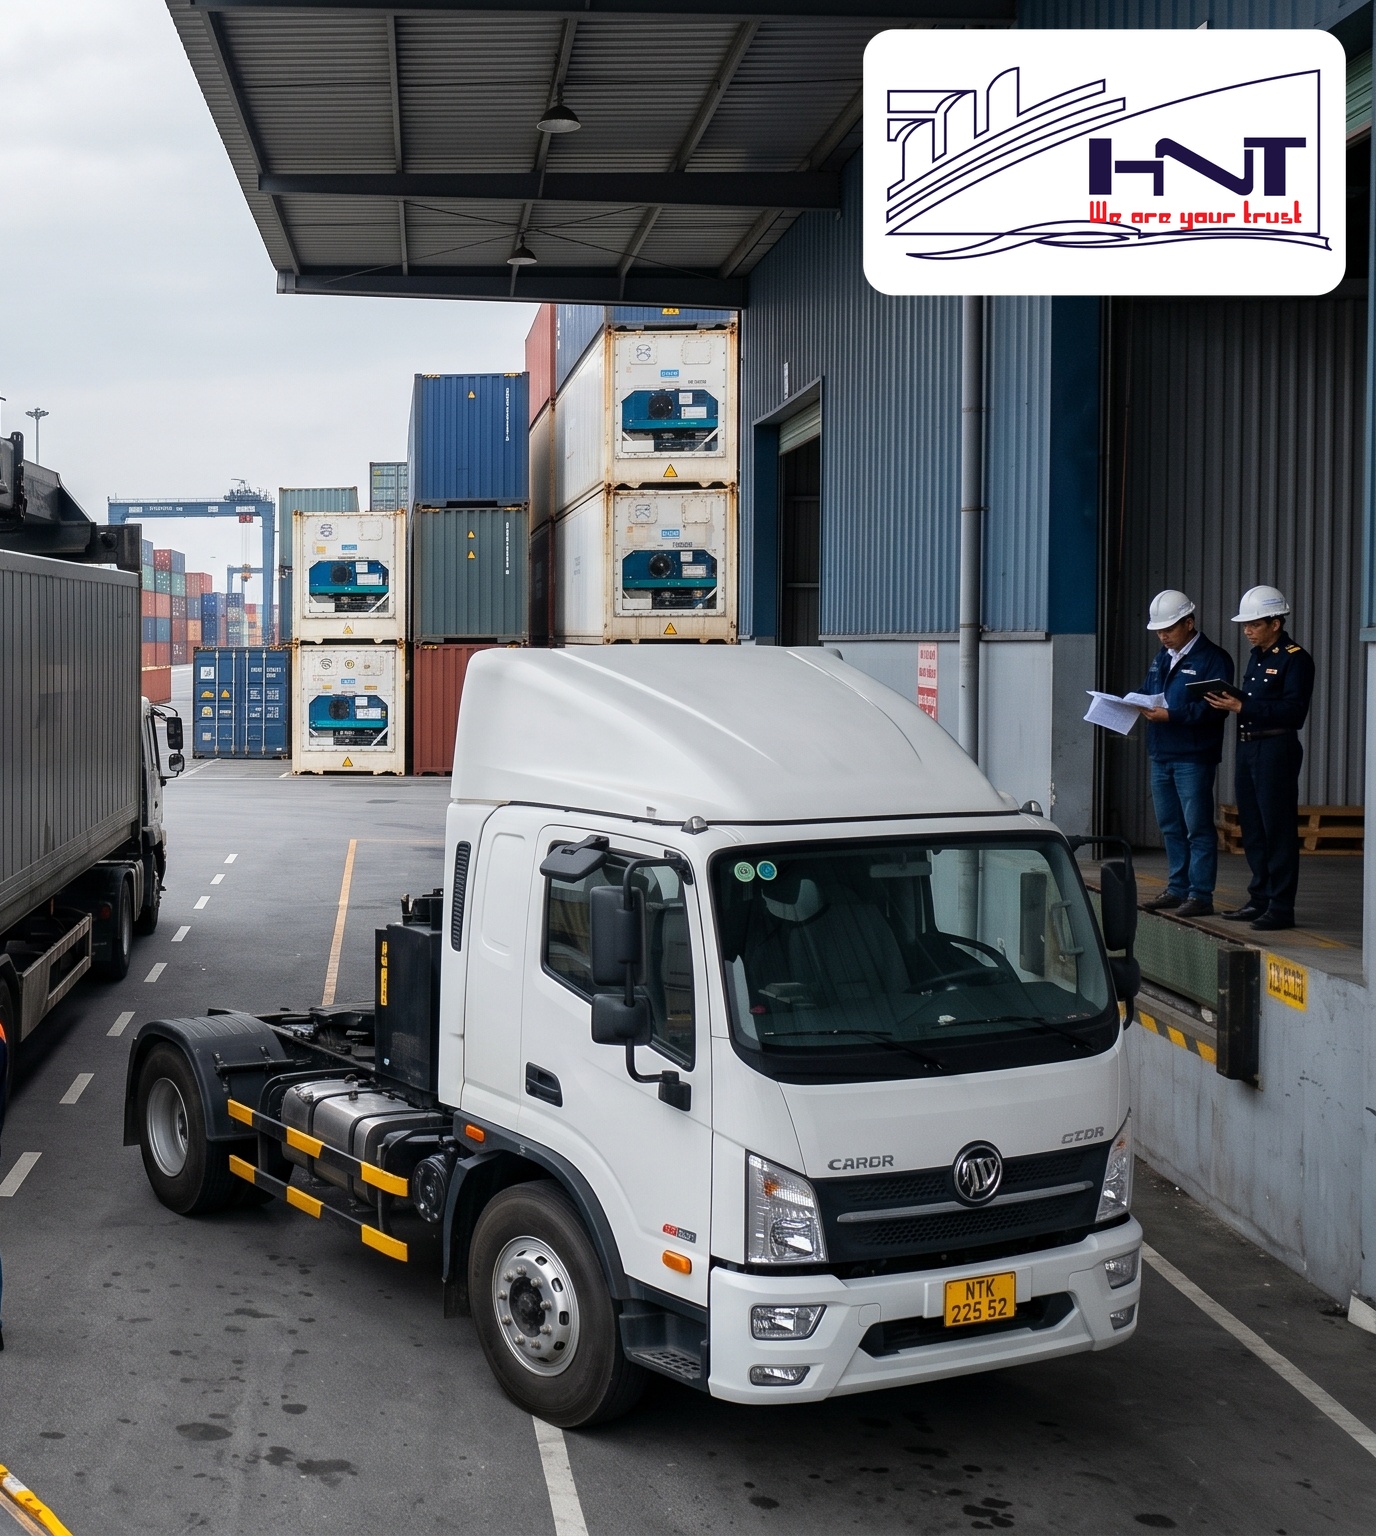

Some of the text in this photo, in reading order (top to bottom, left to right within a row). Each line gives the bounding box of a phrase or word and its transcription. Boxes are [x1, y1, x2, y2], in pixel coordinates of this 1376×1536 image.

[965, 1278, 995, 1301] NTK
[951, 1297, 1007, 1324] 225 52
